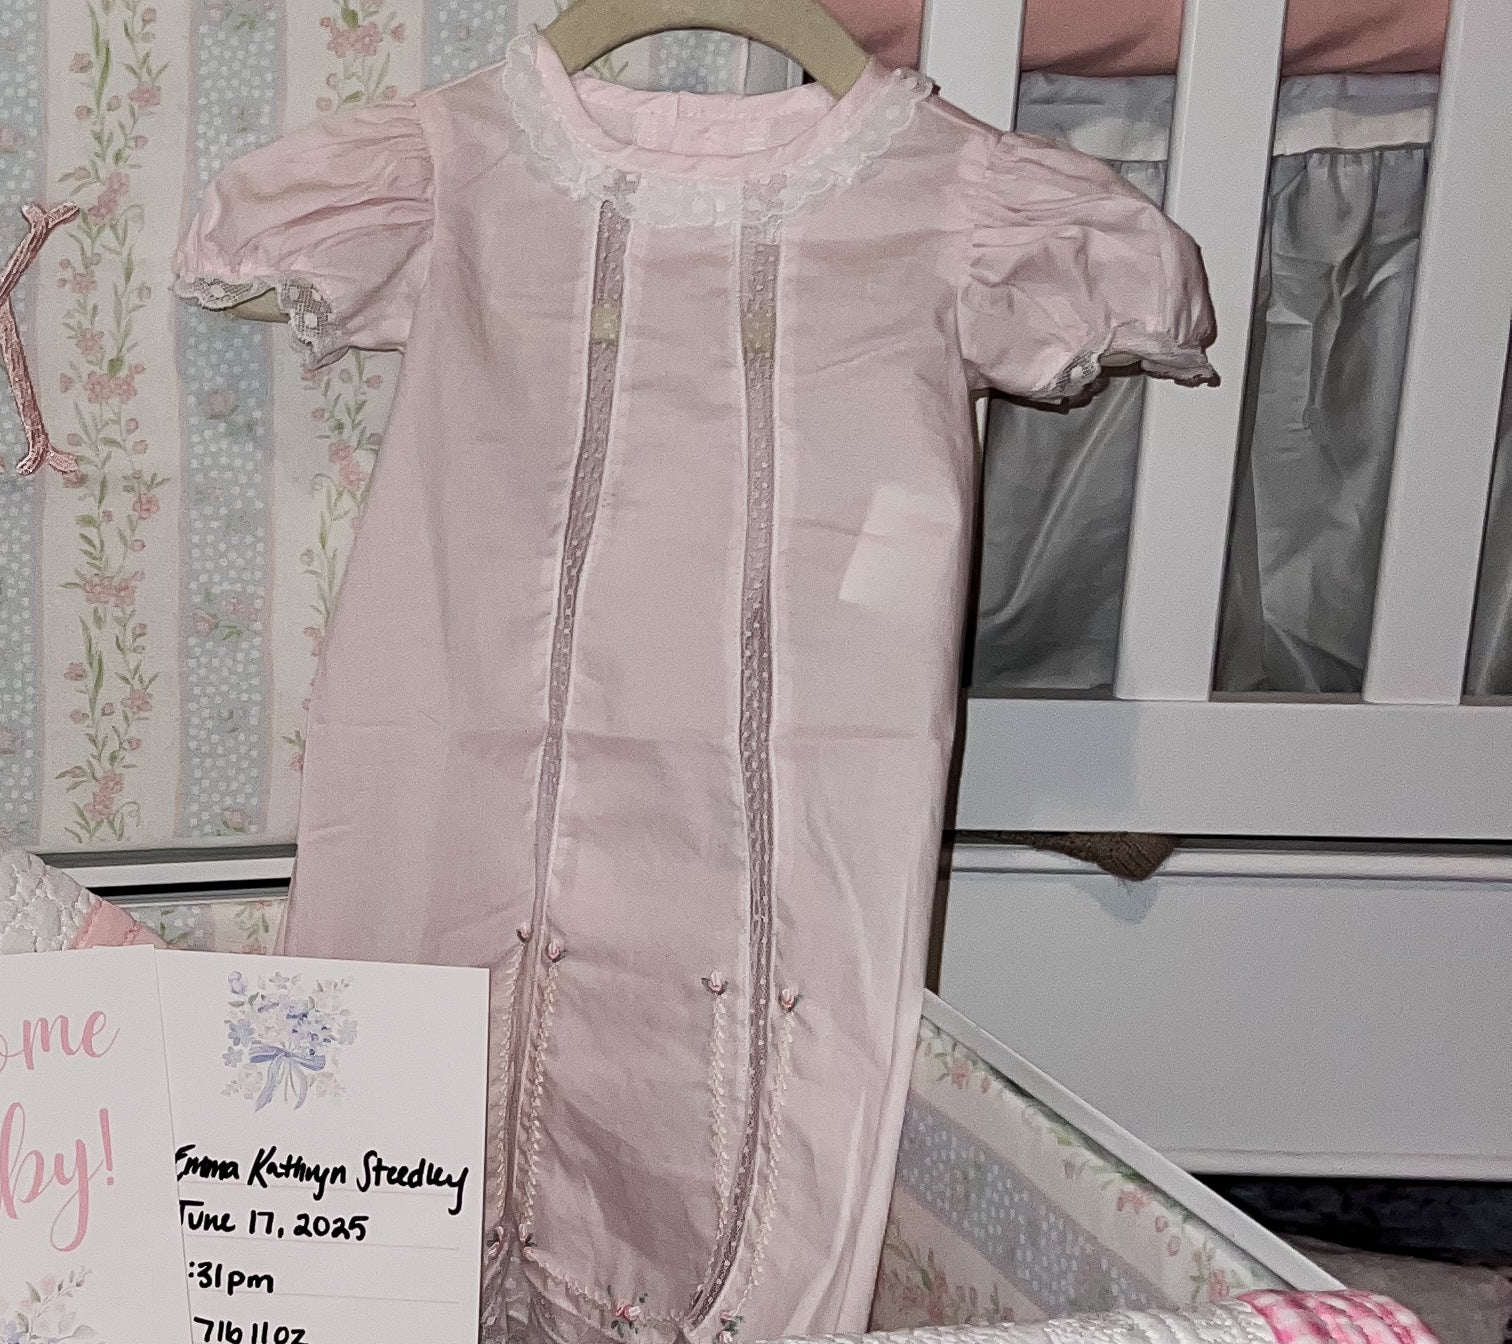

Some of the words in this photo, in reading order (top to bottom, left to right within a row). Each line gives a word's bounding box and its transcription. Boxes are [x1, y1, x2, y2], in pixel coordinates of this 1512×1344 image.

[175, 1144, 239, 1182] Emma
[247, 1145, 347, 1201] Kathryn
[356, 1149, 469, 1216] Steedley
[248, 1209, 284, 1238] 17,
[293, 1213, 370, 1241] 2025
[188, 1260, 275, 1296] :31pm
